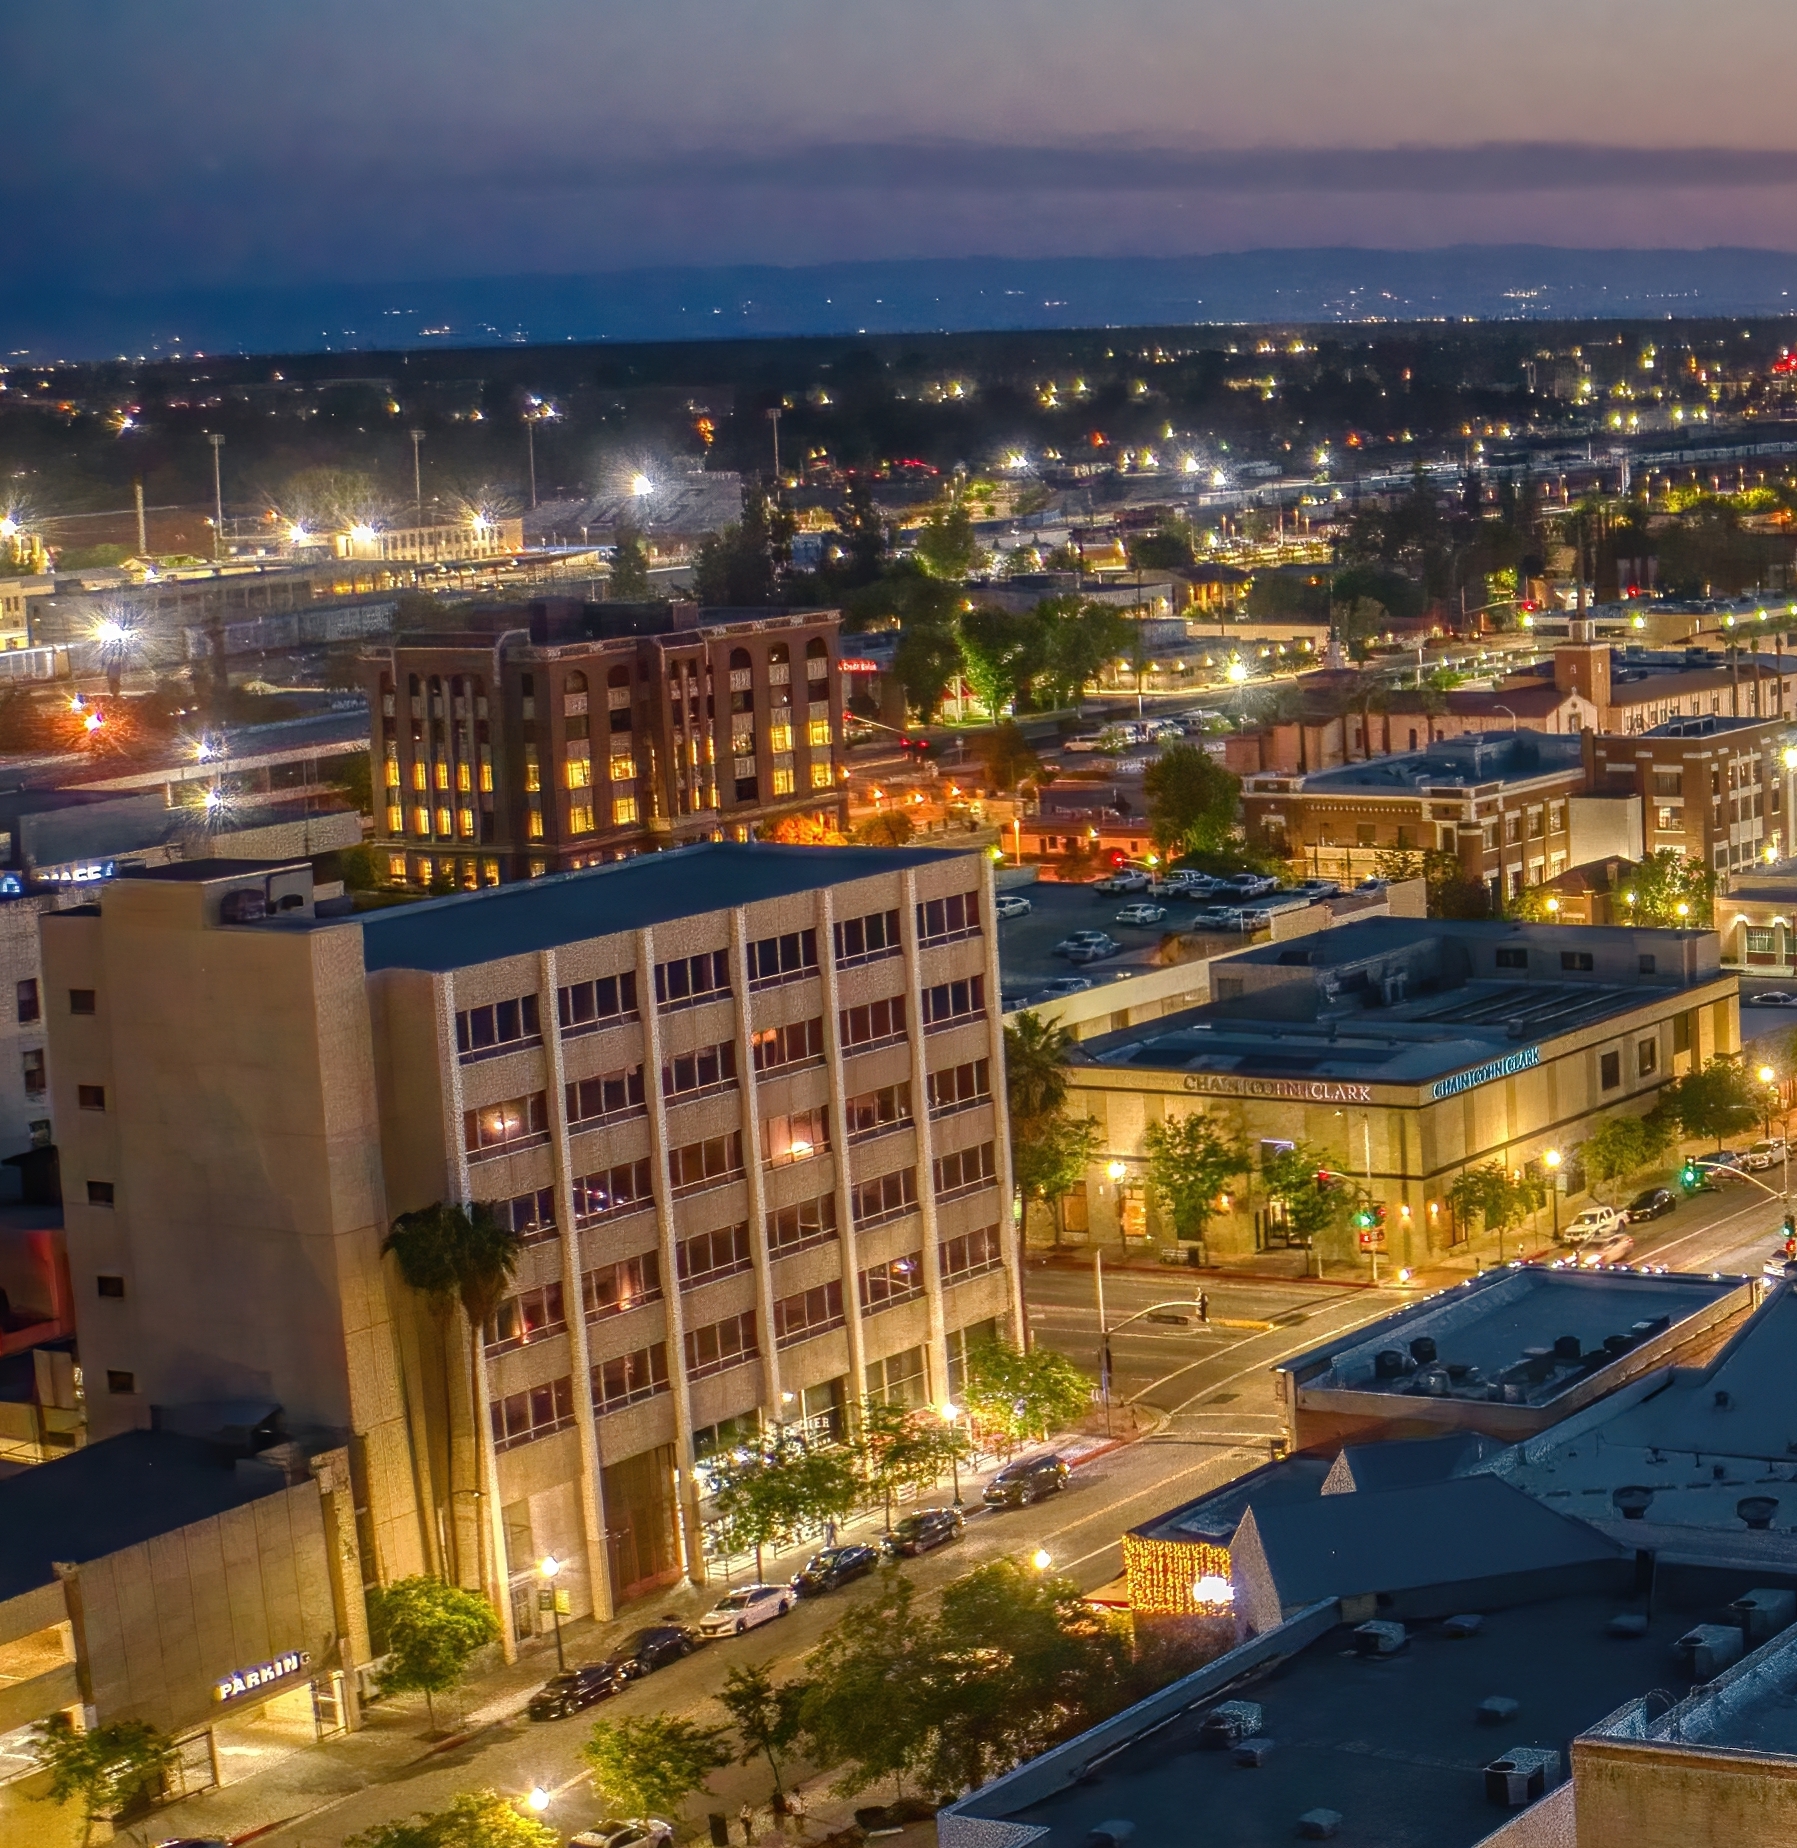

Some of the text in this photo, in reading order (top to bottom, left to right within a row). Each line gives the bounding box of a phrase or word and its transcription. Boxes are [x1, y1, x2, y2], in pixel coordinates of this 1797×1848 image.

[1506, 1046, 1540, 1073] CLARK
[1311, 1083, 1371, 1101] CLARK
[219, 1651, 312, 1701] PARKING
